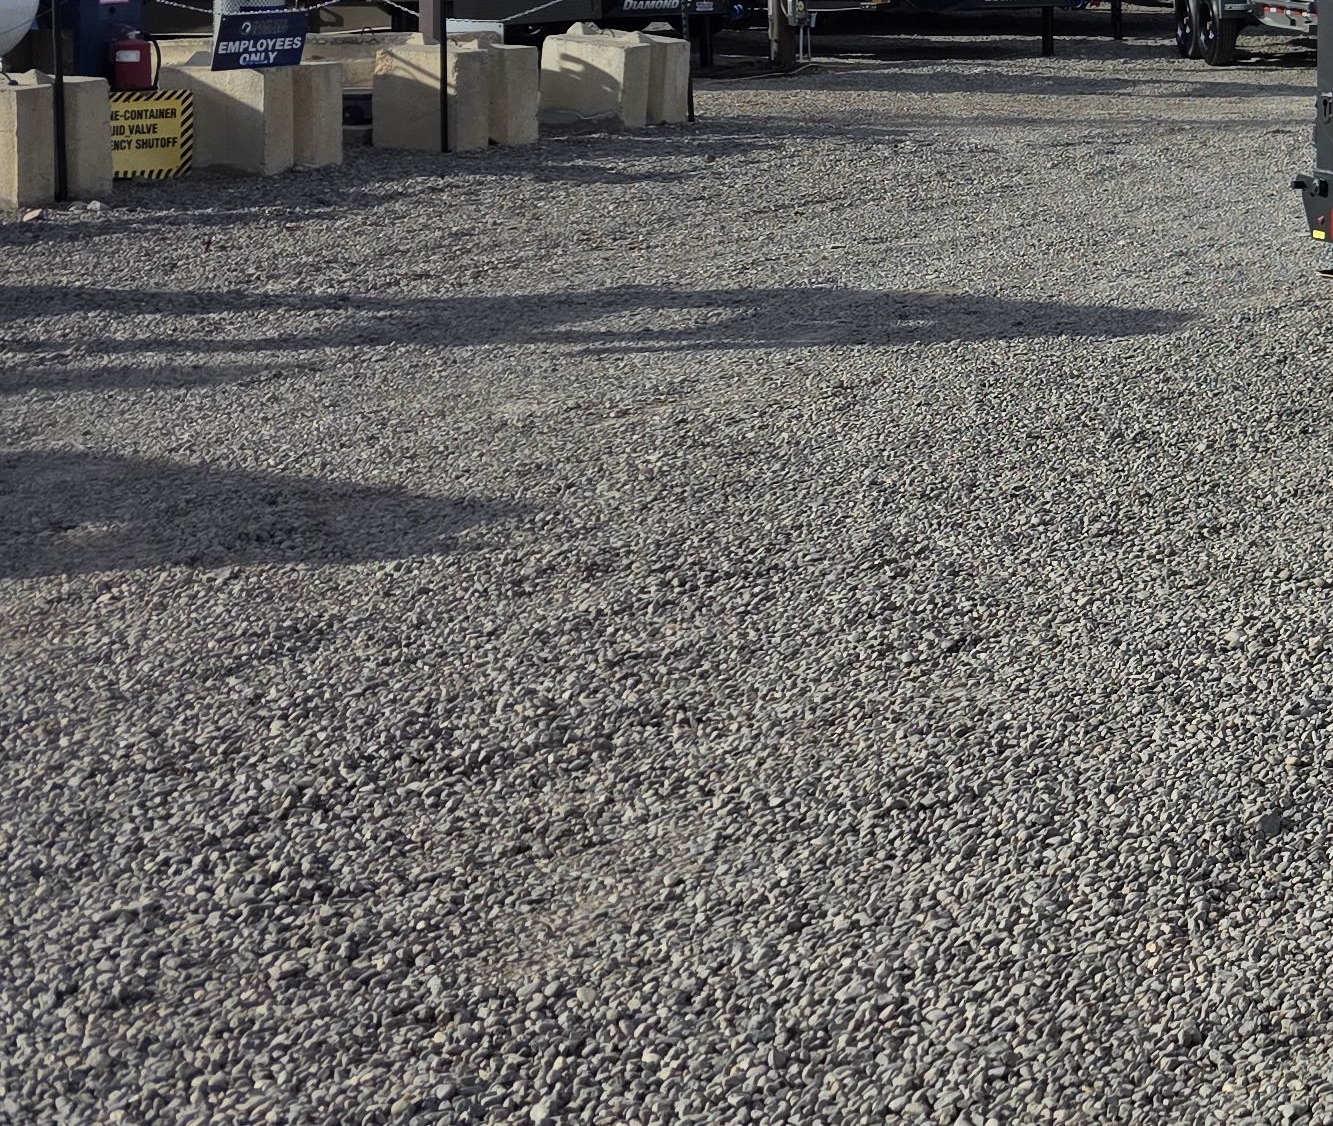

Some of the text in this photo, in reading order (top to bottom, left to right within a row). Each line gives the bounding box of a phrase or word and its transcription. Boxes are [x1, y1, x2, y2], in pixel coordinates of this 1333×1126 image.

[622, 0, 680, 11] DIAMOND
[218, 36, 302, 54] EMPLOYEES
[239, 51, 278, 66] ONLY
[128, 123, 158, 135] VALVE
[135, 137, 178, 149] SHUTOFF
